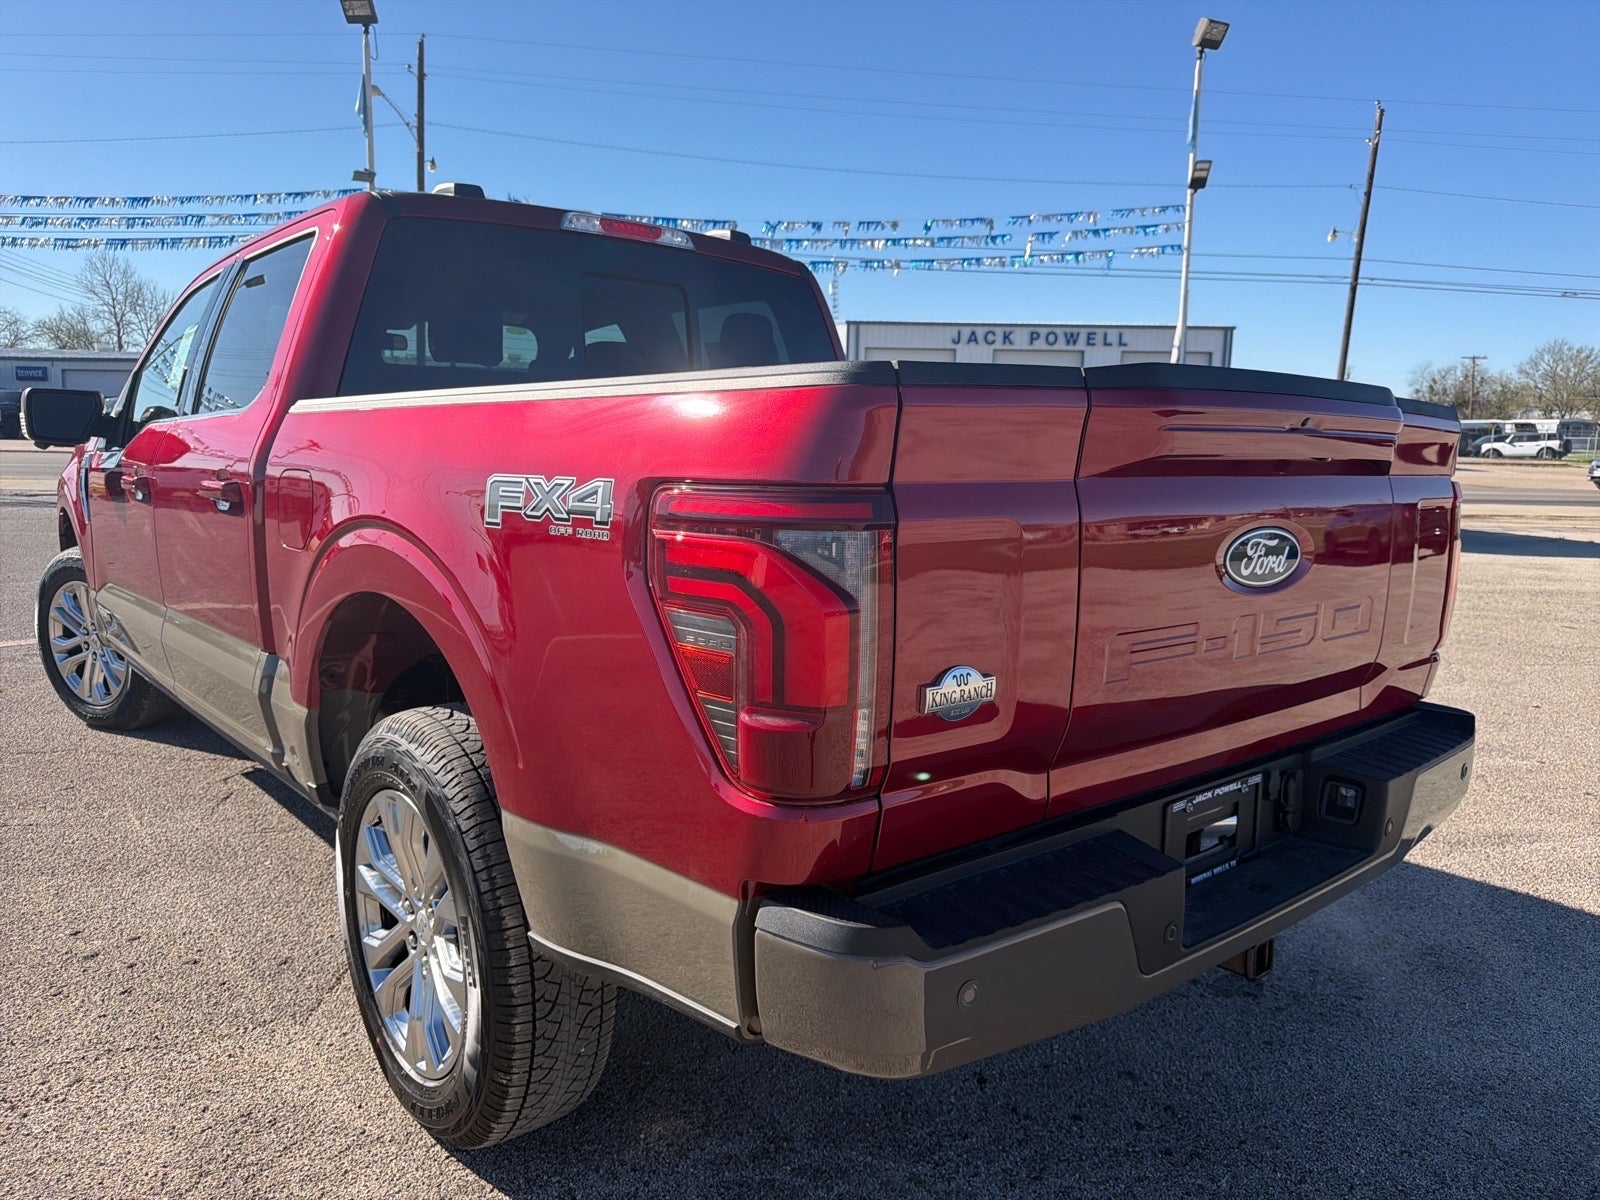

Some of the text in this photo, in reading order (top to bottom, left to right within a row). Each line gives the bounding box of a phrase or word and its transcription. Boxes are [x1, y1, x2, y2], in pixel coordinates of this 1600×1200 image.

[952, 330, 1128, 347] JACK POWELL
[484, 473, 615, 529] FX4
[549, 525, 610, 540] OFF ROAD
[1240, 538, 1290, 576] Ford
[1104, 596, 1374, 684] F-150
[931, 682, 993, 708] KING RANCH
[1192, 791, 1213, 804] JACK
